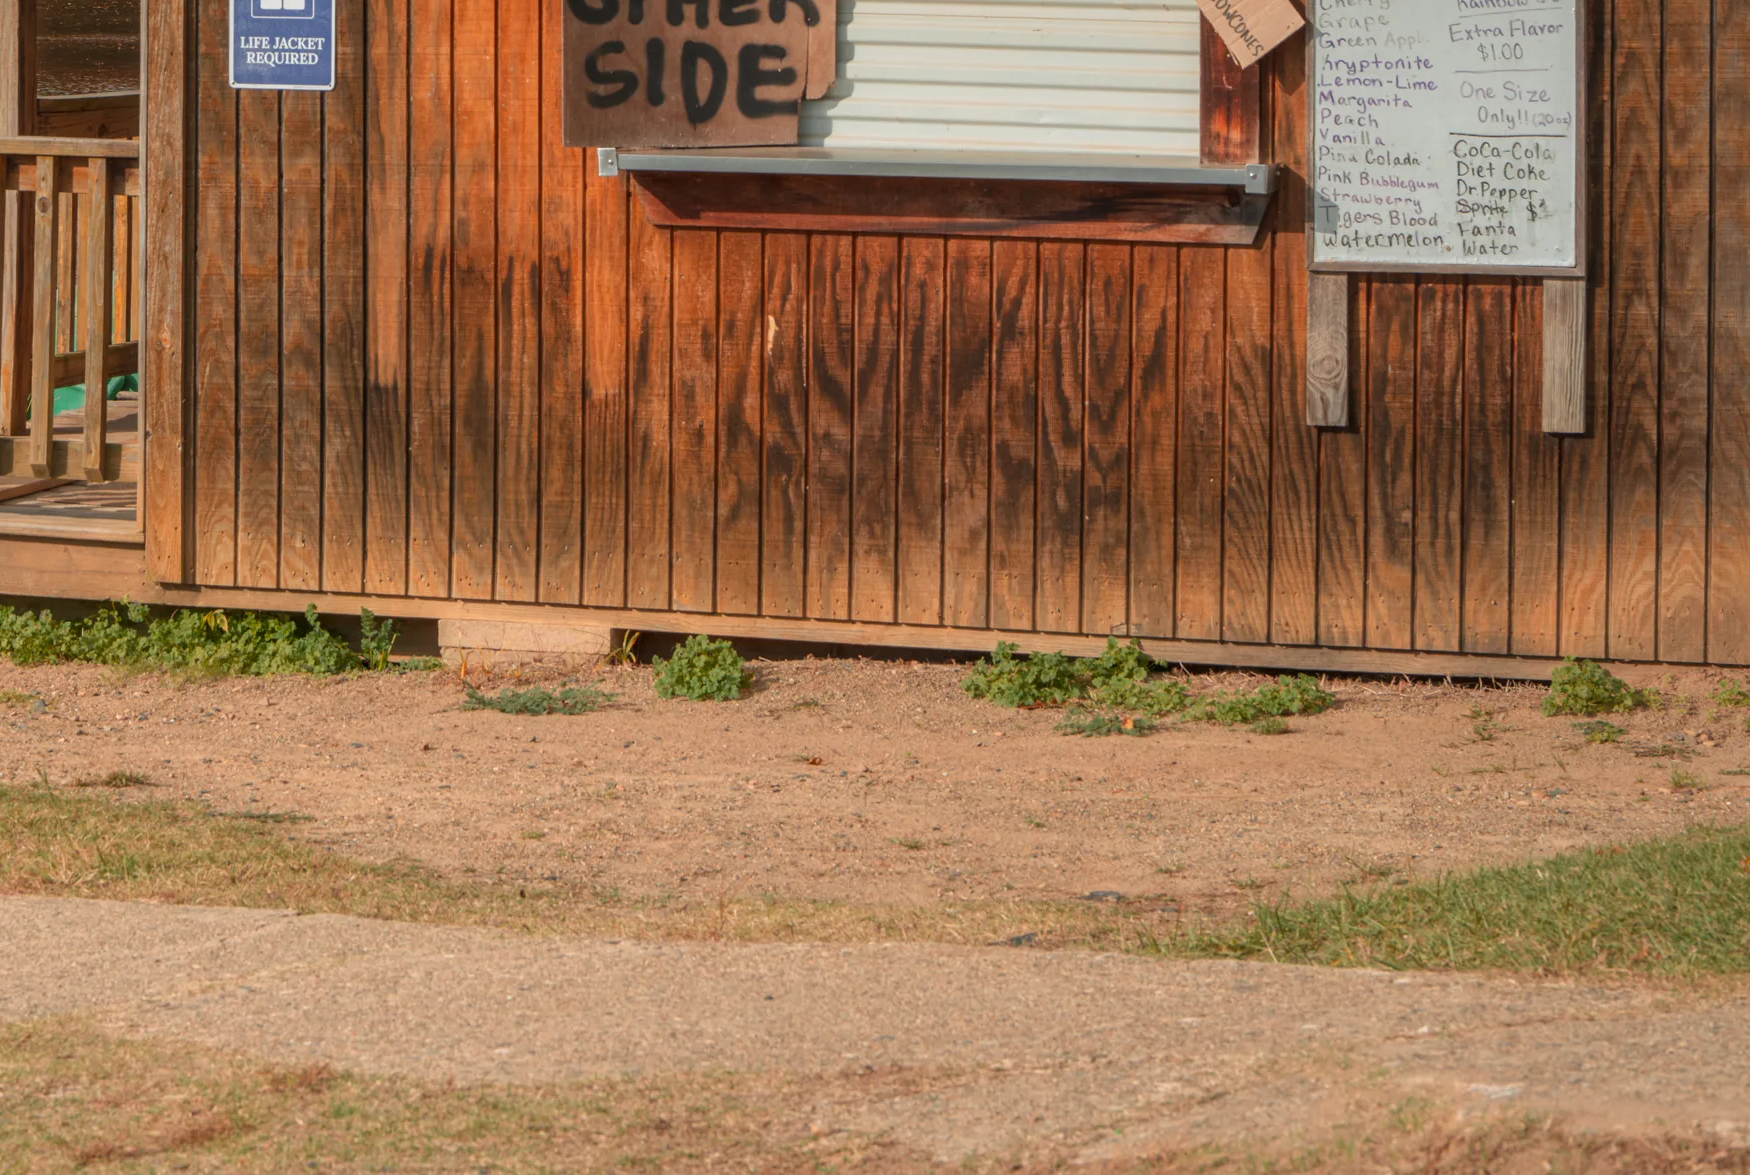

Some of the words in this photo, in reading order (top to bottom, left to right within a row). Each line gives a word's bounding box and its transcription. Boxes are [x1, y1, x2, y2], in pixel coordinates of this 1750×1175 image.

[1318, 12, 1390, 32] Grape
[1449, 23, 1504, 42] Extra
[1510, 18, 1564, 37] Flavor
[240, 36, 270, 49] LIFE
[273, 36, 325, 51] JACKET
[1319, 31, 1378, 49] Green
[1385, 30, 1431, 50] Appl
[246, 51, 319, 67] REQUIRED
[1477, 42, 1524, 62] $1.00
[584, 37, 799, 126] SIDE
[1460, 80, 1496, 100] One
[1502, 80, 1551, 103] Size
[1319, 90, 1413, 114] Margarita
[1321, 107, 1379, 129] Peach
[1319, 127, 1386, 146] Vanilla
[1365, 148, 1421, 166] Colada
[1318, 165, 1352, 184] Pink
[1360, 170, 1439, 192] Bubblegum
[1457, 160, 1495, 178] Diet
[1503, 162, 1551, 181] Coke
[1320, 187, 1423, 215] Strawberry
[1456, 198, 1508, 217] Sprite
[1318, 205, 1383, 229] Tigers
[1389, 209, 1438, 227] Blood
[1323, 229, 1444, 248] Watermelon
[1457, 220, 1517, 237] Fanta
[1462, 239, 1519, 256] Water
